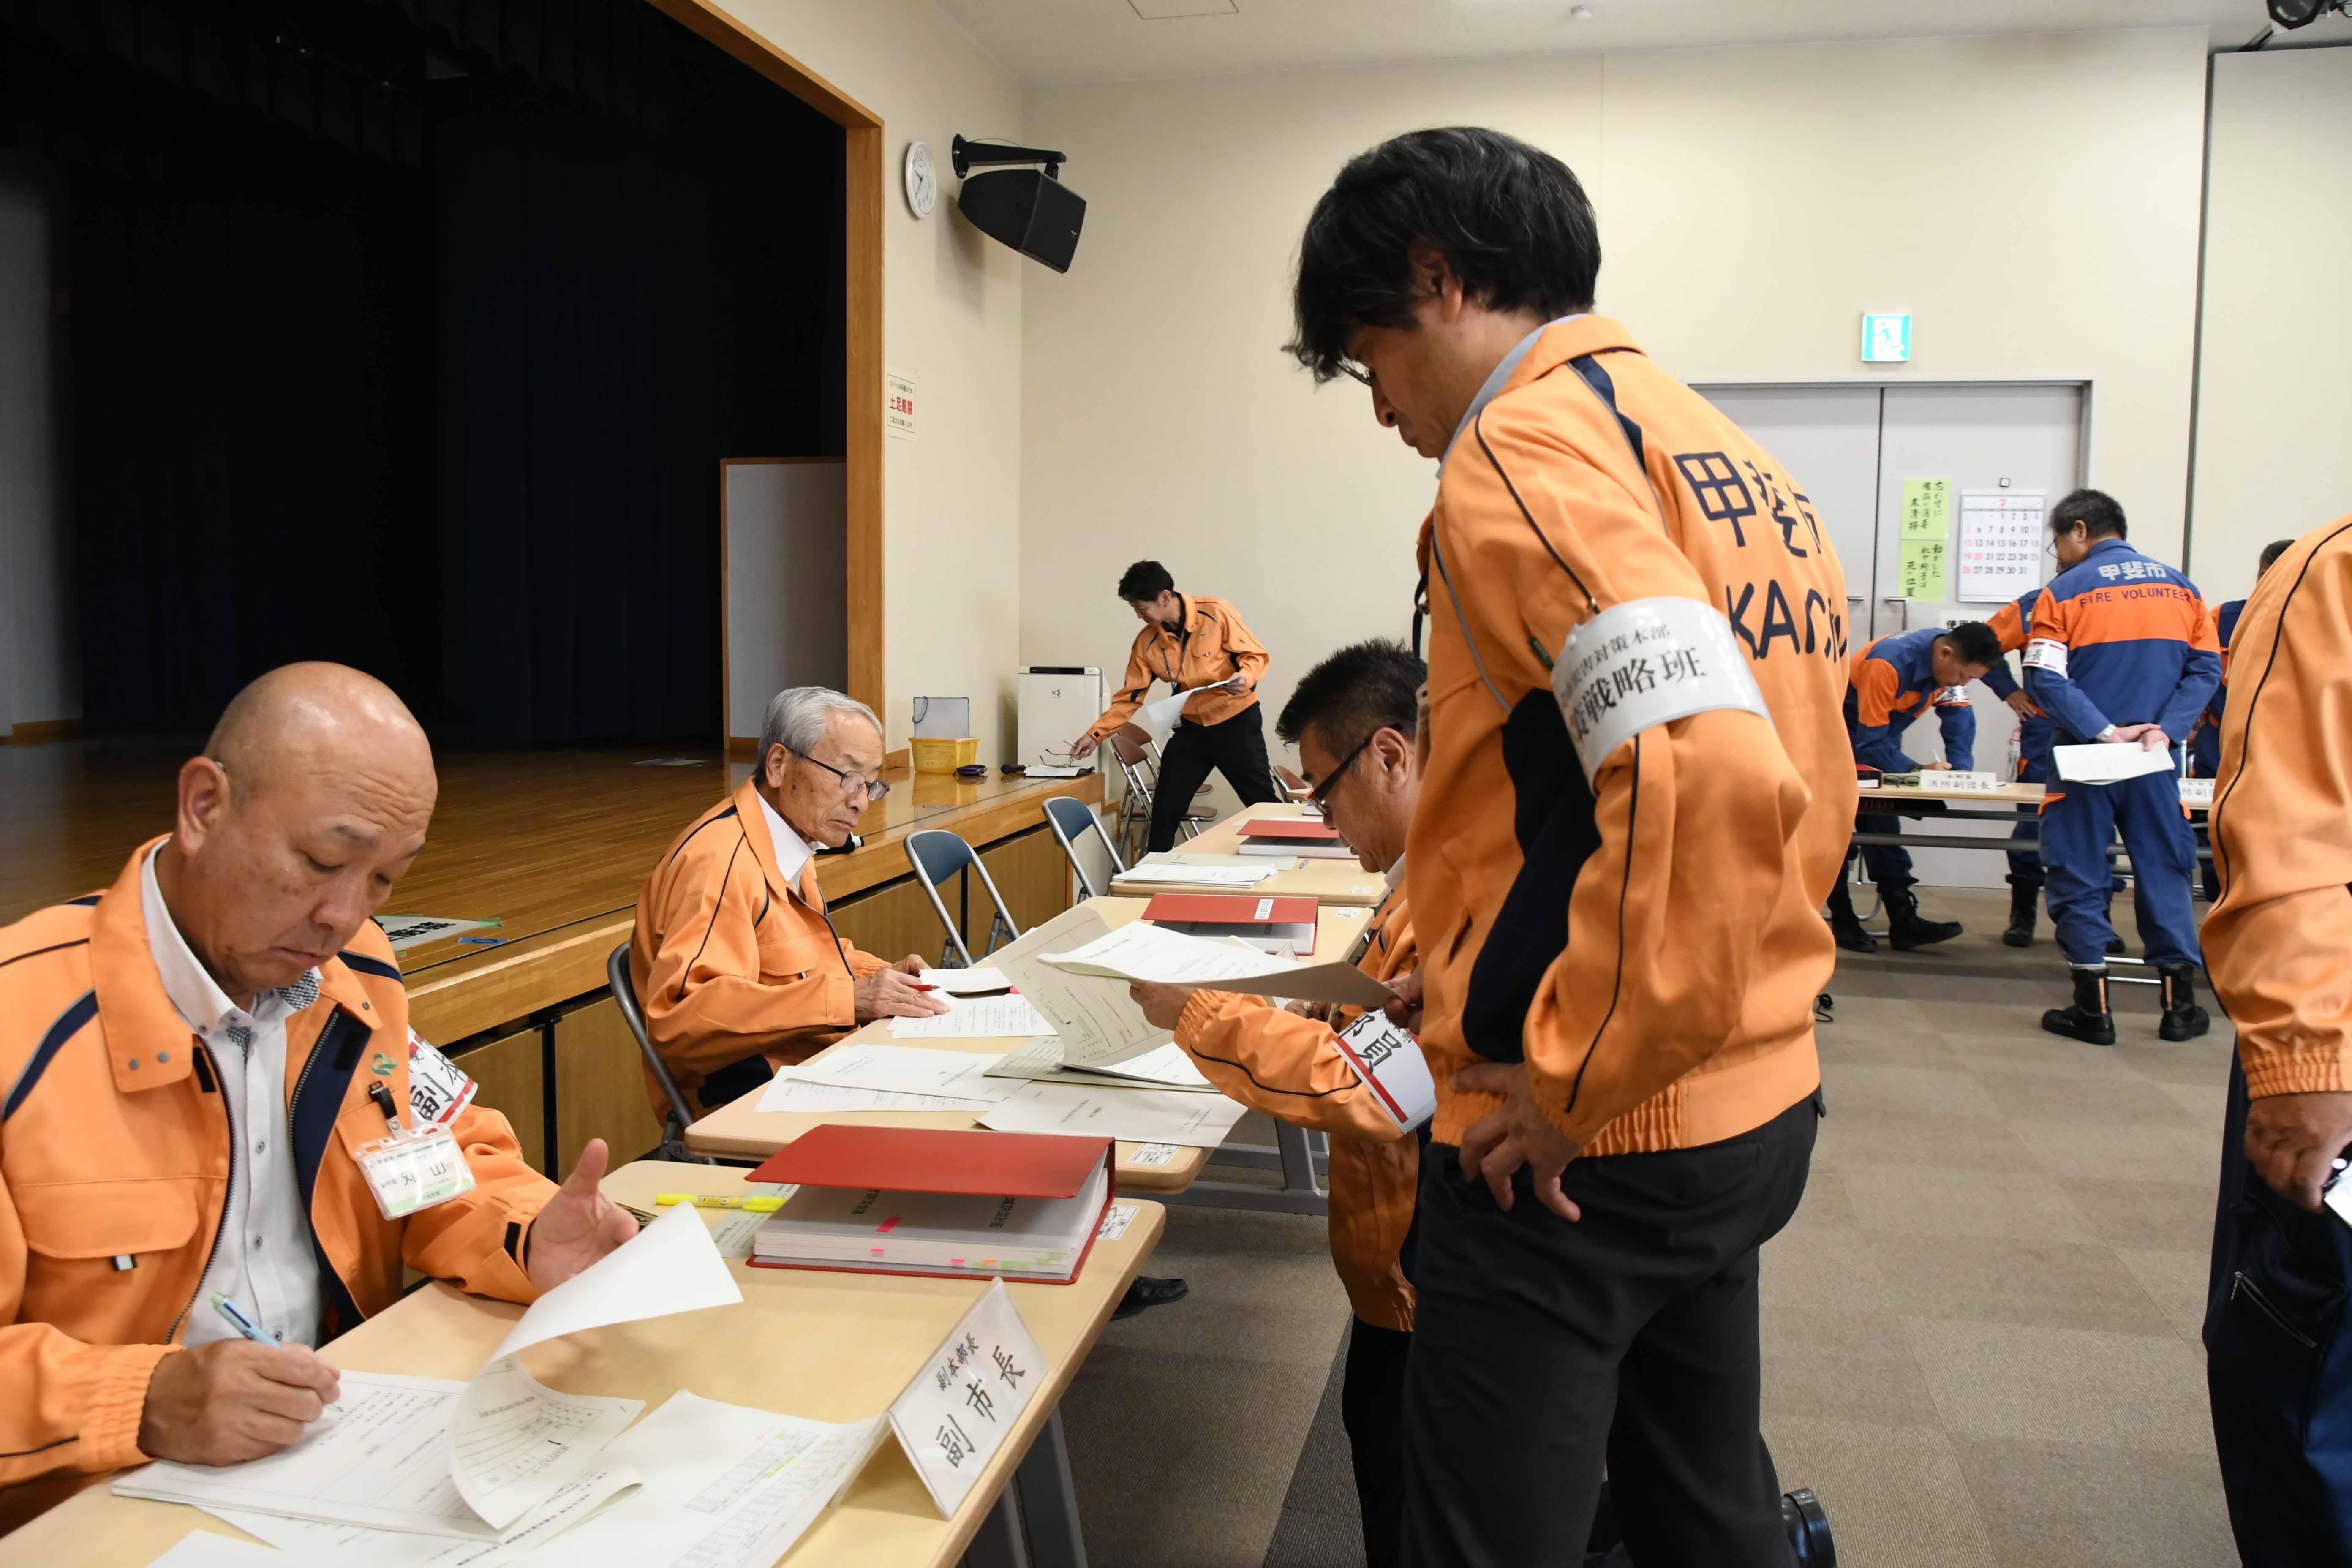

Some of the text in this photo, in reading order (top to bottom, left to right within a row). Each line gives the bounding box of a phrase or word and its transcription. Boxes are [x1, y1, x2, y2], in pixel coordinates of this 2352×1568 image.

[890, 394, 913, 415] 土足厳禁
[2099, 561, 2167, 580] 甲斐市
[2080, 588, 2190, 608] FIRE VOLUNTEER
[1927, 780, 1991, 790] 消防副団長
[936, 1332, 979, 1391] 副本部長
[936, 1345, 1026, 1468] 副市長
